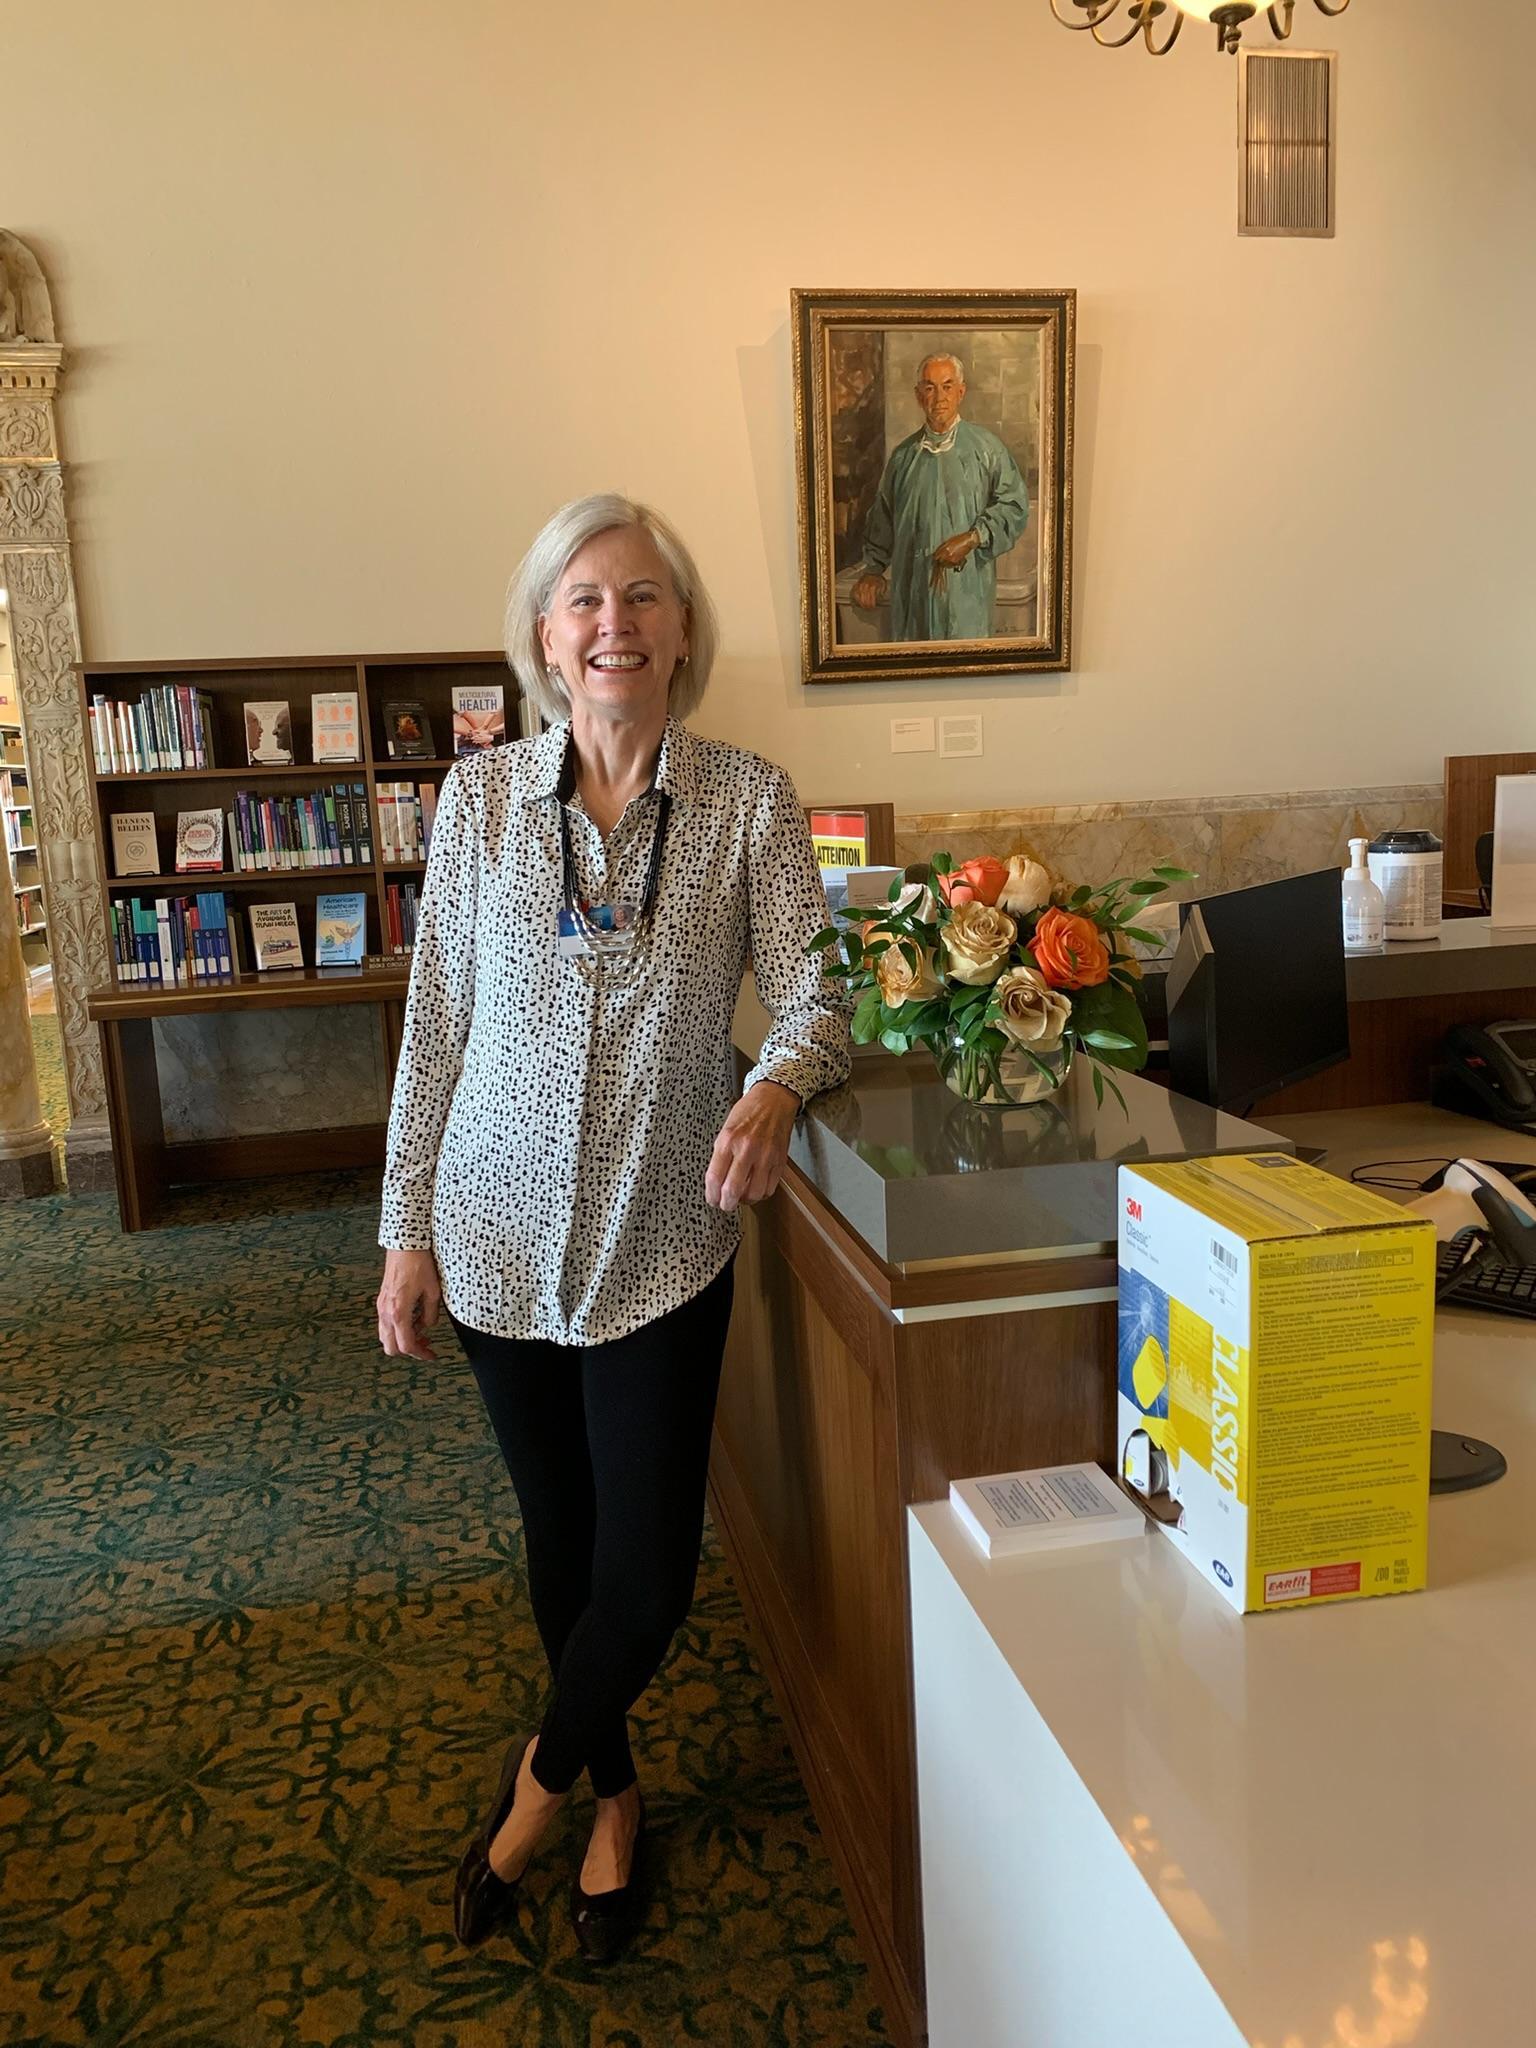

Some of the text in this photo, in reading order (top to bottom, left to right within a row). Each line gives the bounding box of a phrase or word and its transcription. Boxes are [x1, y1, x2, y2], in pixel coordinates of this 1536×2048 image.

[458, 691, 497, 699] MULTICULTURAL
[459, 699, 498, 711] HEALTH
[343, 803, 352, 830] ROSEN'S
[361, 802, 370, 829] ROSEN'S
[117, 824, 152, 833] BELIEFS
[816, 846, 860, 867] ATTENTION
[1126, 1197, 1142, 1222] 3M
[1126, 1220, 1149, 1248] Classic
[1211, 1328, 1239, 1500] CLASSIC
